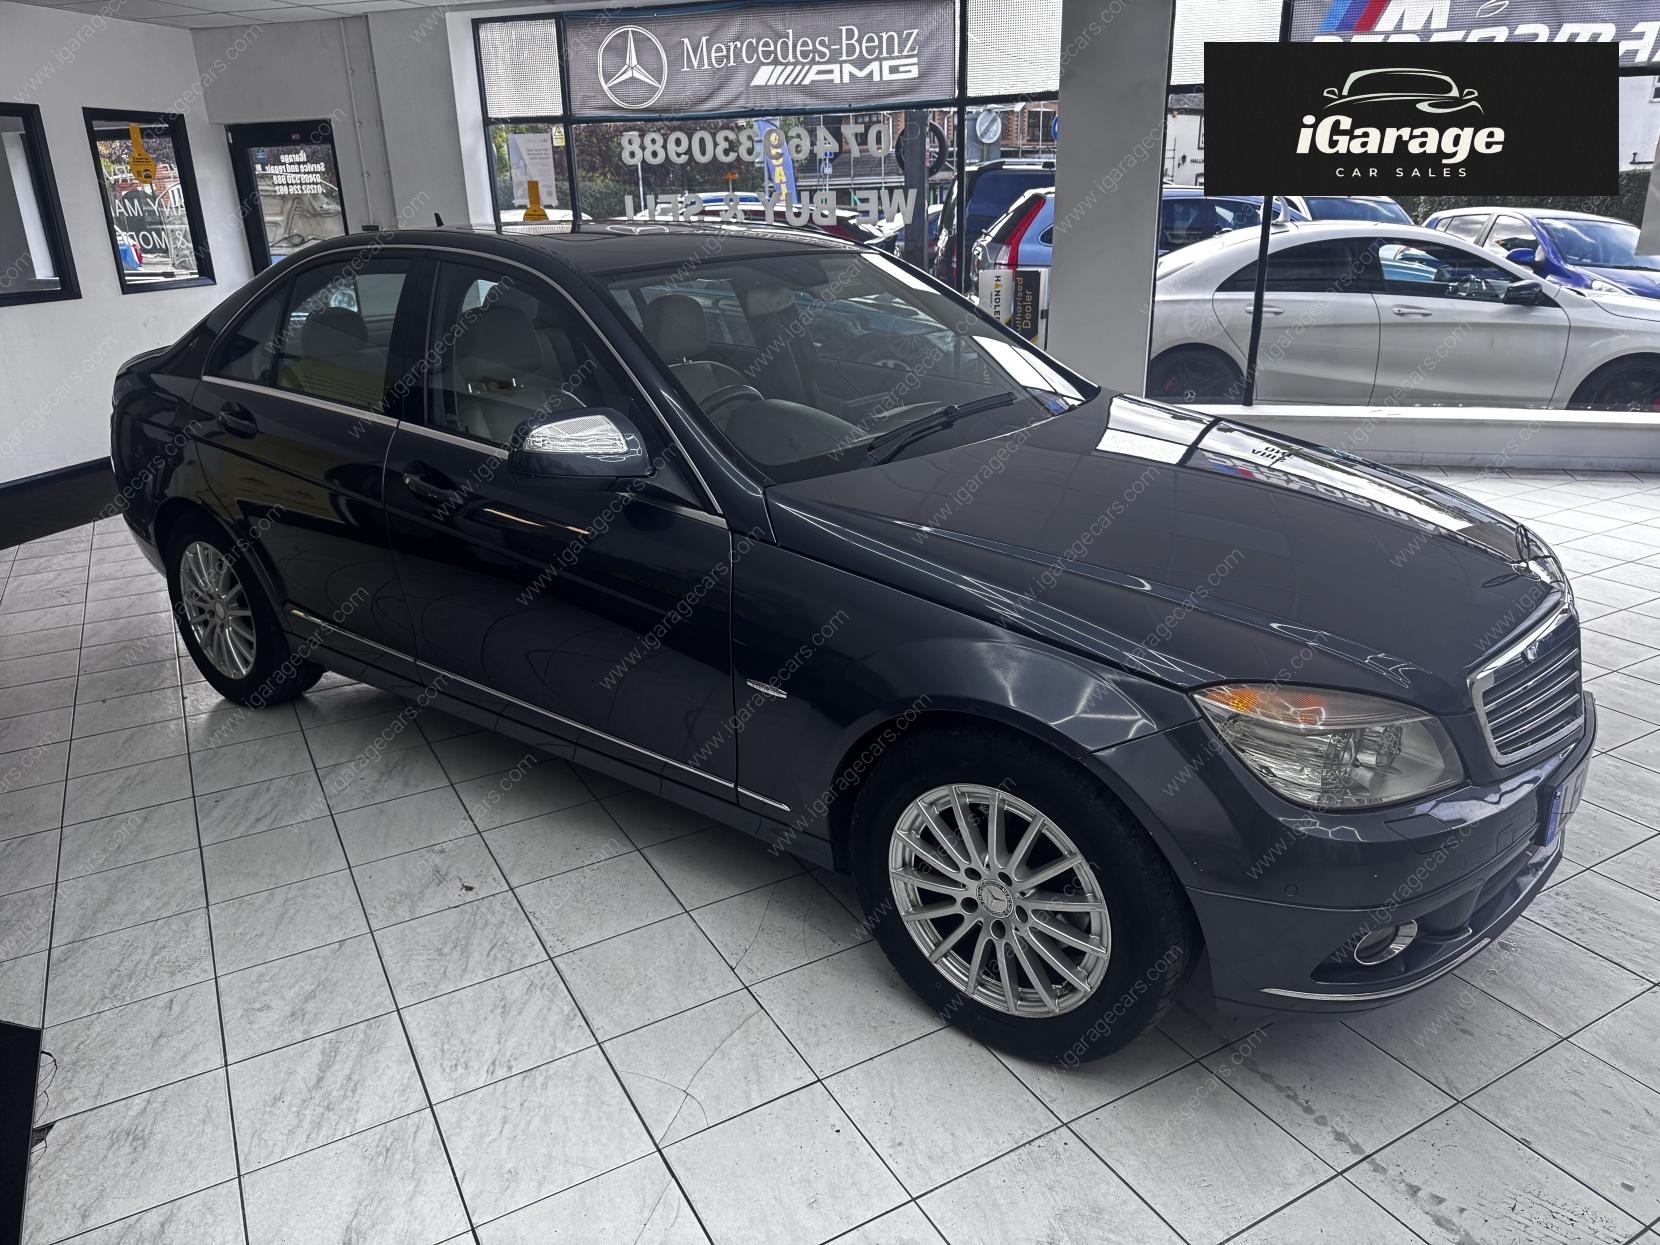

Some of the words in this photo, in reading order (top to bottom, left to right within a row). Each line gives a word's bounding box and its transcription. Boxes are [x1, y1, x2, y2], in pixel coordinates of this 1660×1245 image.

[681, 26, 919, 71] Mercedes-Benz
[1015, 277, 1023, 335] uthorised
[1022, 288, 1033, 329] Dealer
